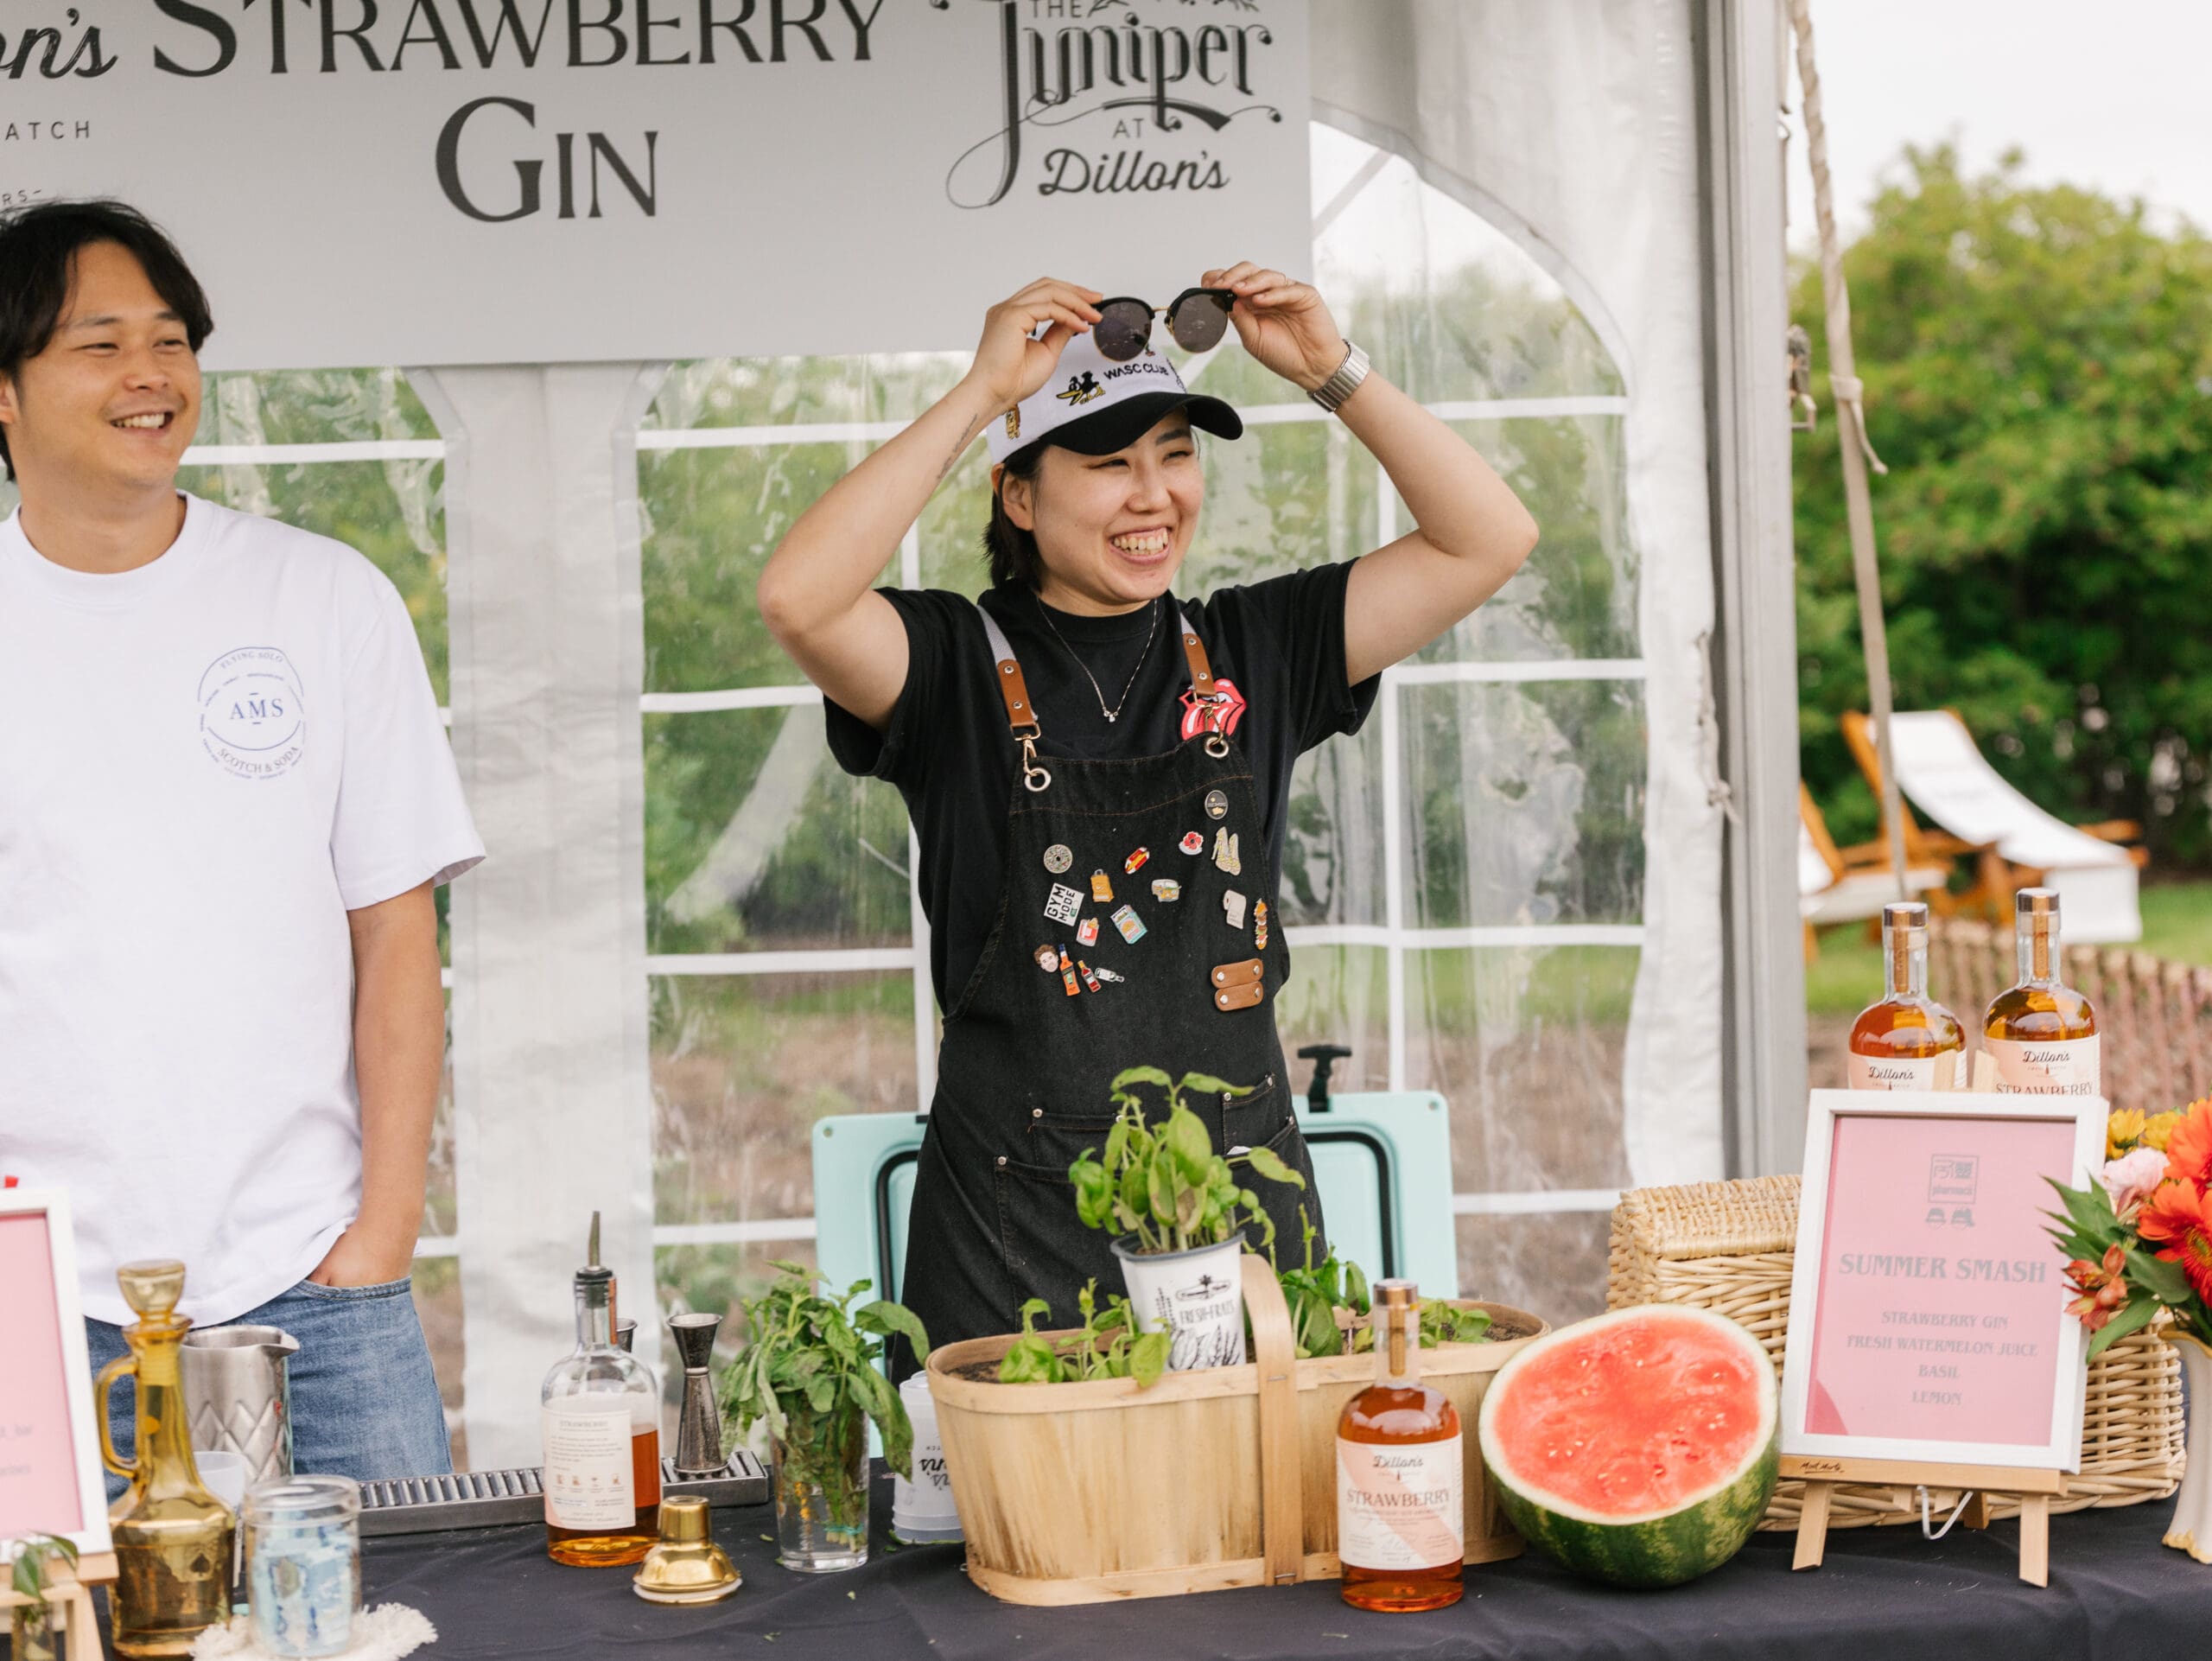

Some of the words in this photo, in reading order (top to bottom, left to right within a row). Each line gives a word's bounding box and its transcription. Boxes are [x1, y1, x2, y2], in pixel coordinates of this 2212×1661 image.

[1029, 0, 1082, 18] THE
[0, 8, 118, 80] n's
[154, 0, 883, 78] STRAWBERRY
[5, 120, 91, 141] ATCH
[1112, 118, 1144, 139] AT
[435, 96, 659, 223] GIN
[1039, 148, 1230, 196] Dillon's
[1103, 363, 1141, 379] WASC
[229, 697, 284, 720] AMS
[218, 747, 262, 773] SCOTCH
[274, 746, 299, 769] SODA
[1046, 885, 1065, 918] GYM
[1058, 890, 1076, 922] MODE
[2022, 1049, 2071, 1064] Dillon's
[1868, 1065, 1915, 1080] Dillon's
[1838, 1252, 1948, 1280] SUMMER
[1955, 1257, 2047, 1283] SMASH
[1881, 1310, 1978, 1328] STRAWBERRY
[1981, 1315, 2009, 1330] GIN
[1846, 1334, 1892, 1350] FRESH
[1897, 1337, 1994, 1355] WATERMELON
[1998, 1343, 2038, 1357] JUICE
[1917, 1364, 1960, 1379] BASIL
[1911, 1390, 1963, 1406] LEMON
[1372, 1454, 1424, 1469] Dillon's
[1346, 1488, 1452, 1508] STRAWBERRY
